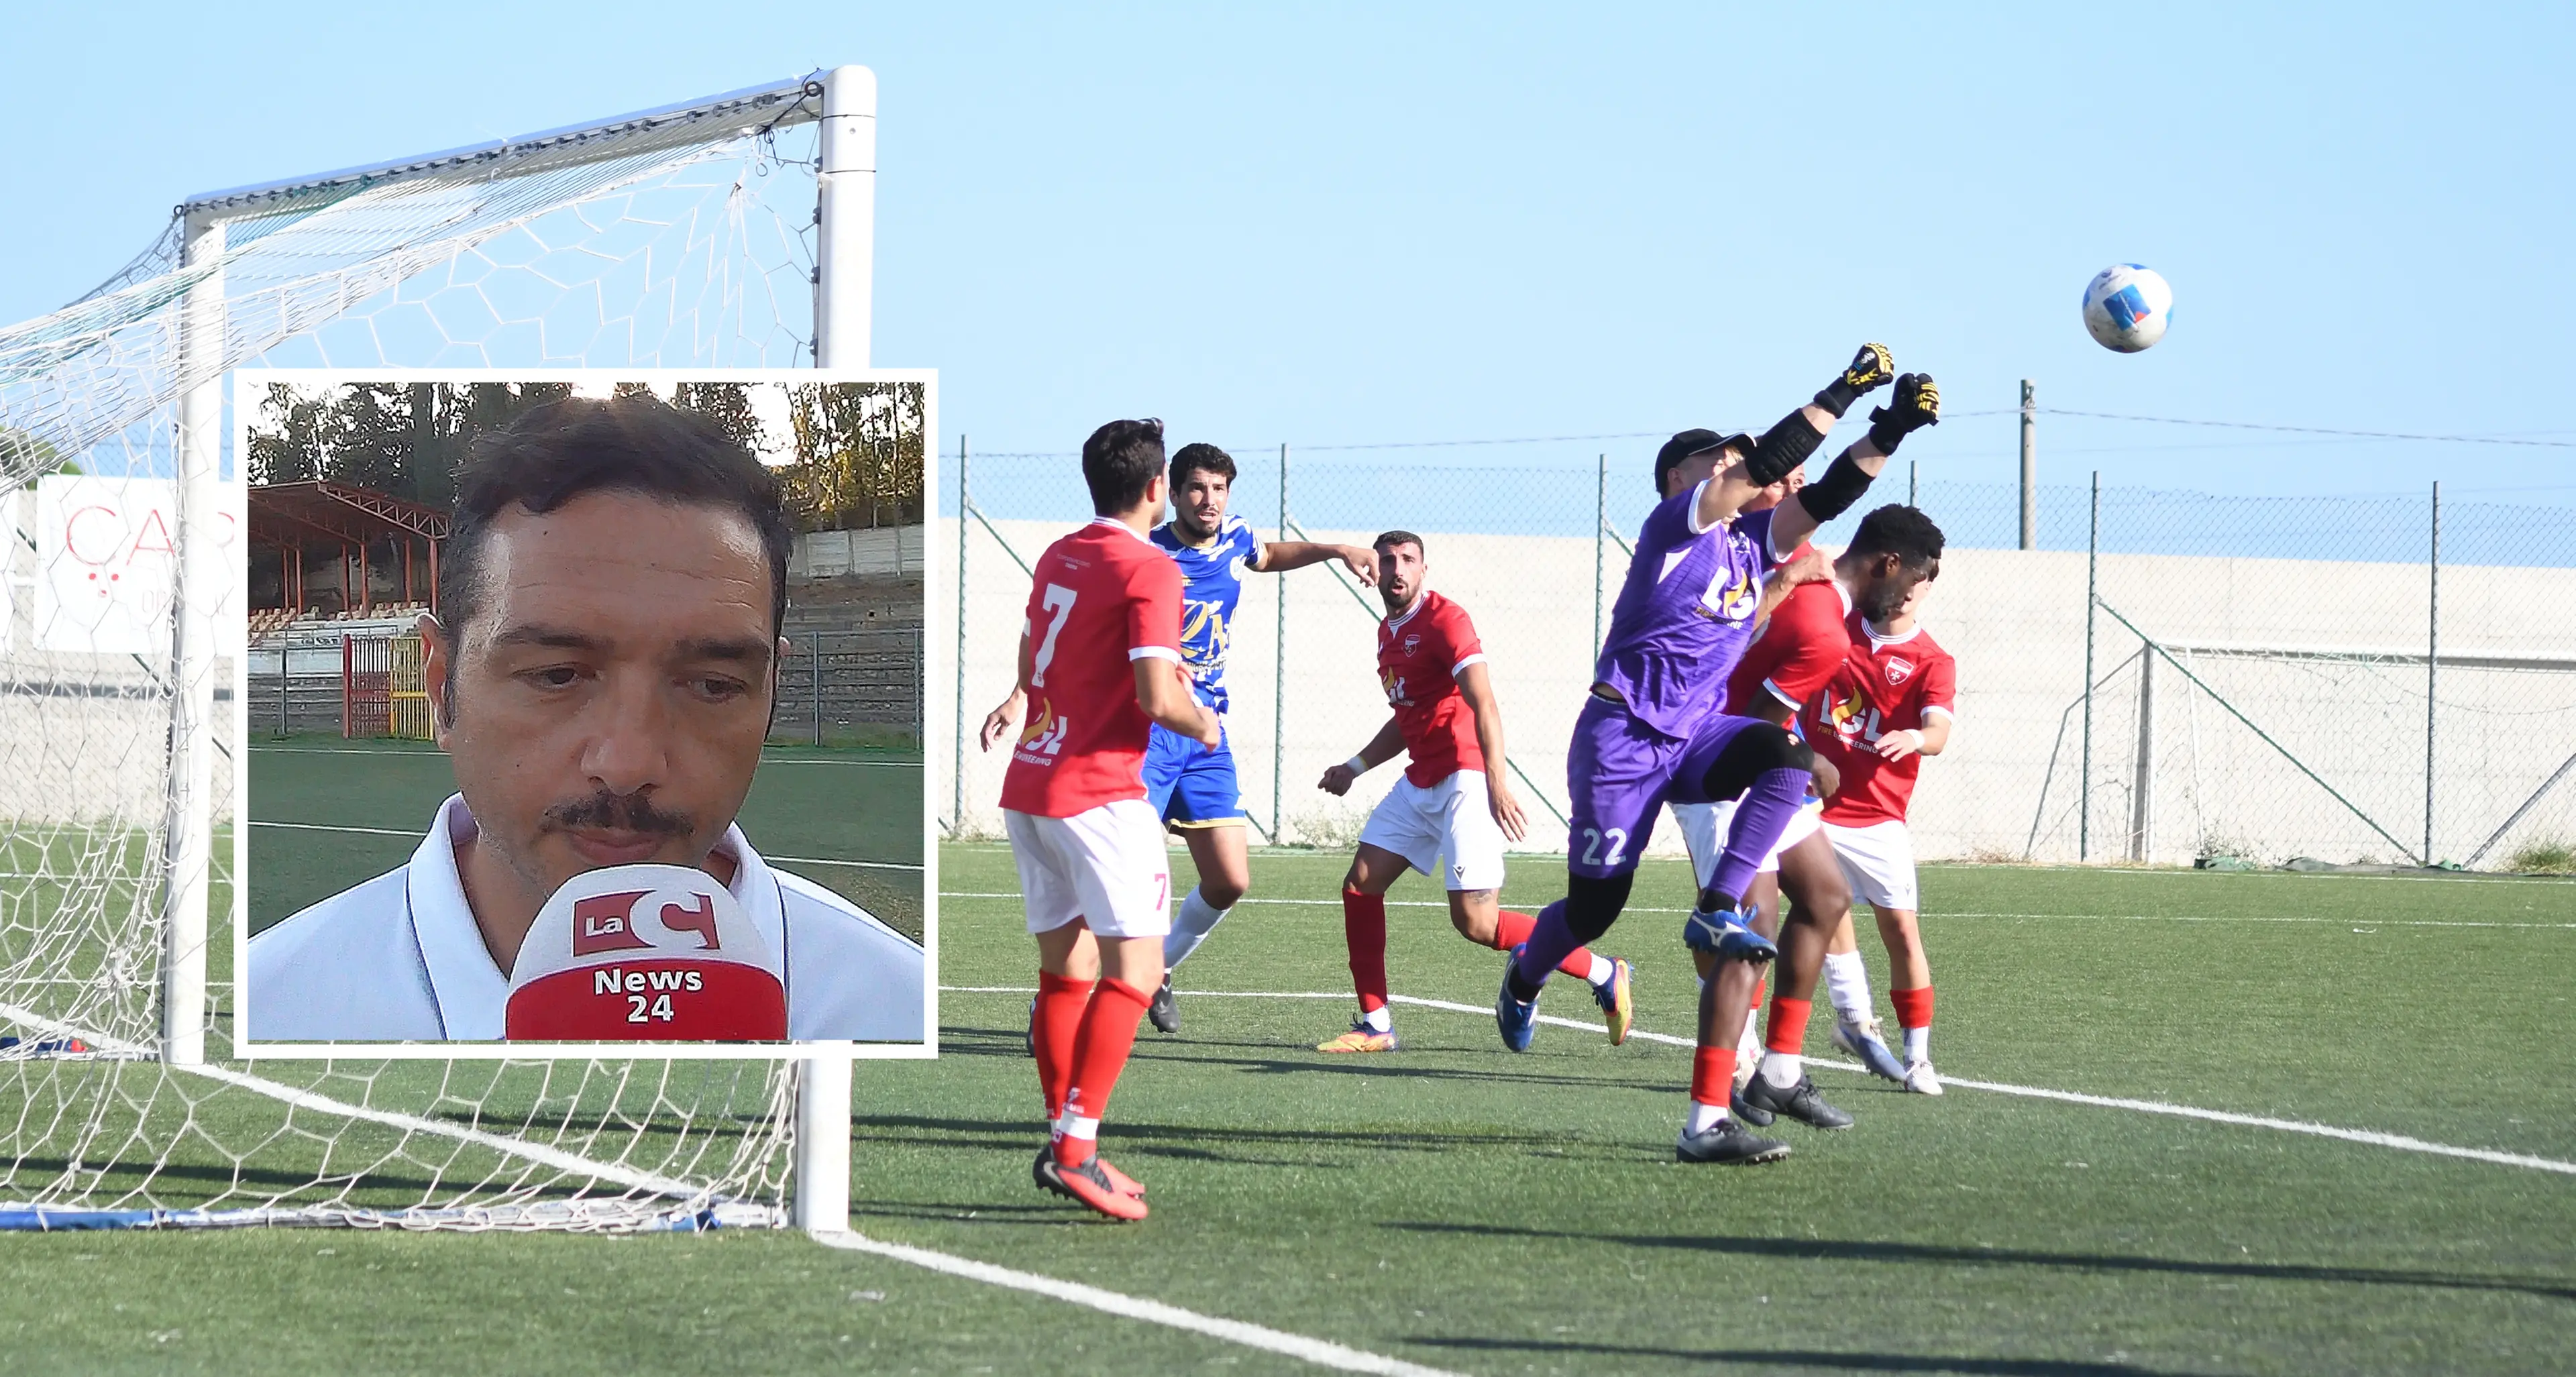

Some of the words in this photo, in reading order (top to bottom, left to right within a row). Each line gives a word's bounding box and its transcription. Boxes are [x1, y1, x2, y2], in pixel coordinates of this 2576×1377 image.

[1031, 582, 1078, 688] 7
[1817, 725, 1833, 736] FIRE
[1582, 827, 1627, 866] 22
[1155, 873, 1167, 911] 7
[594, 968, 703, 995] News
[627, 994, 674, 1023] 24
